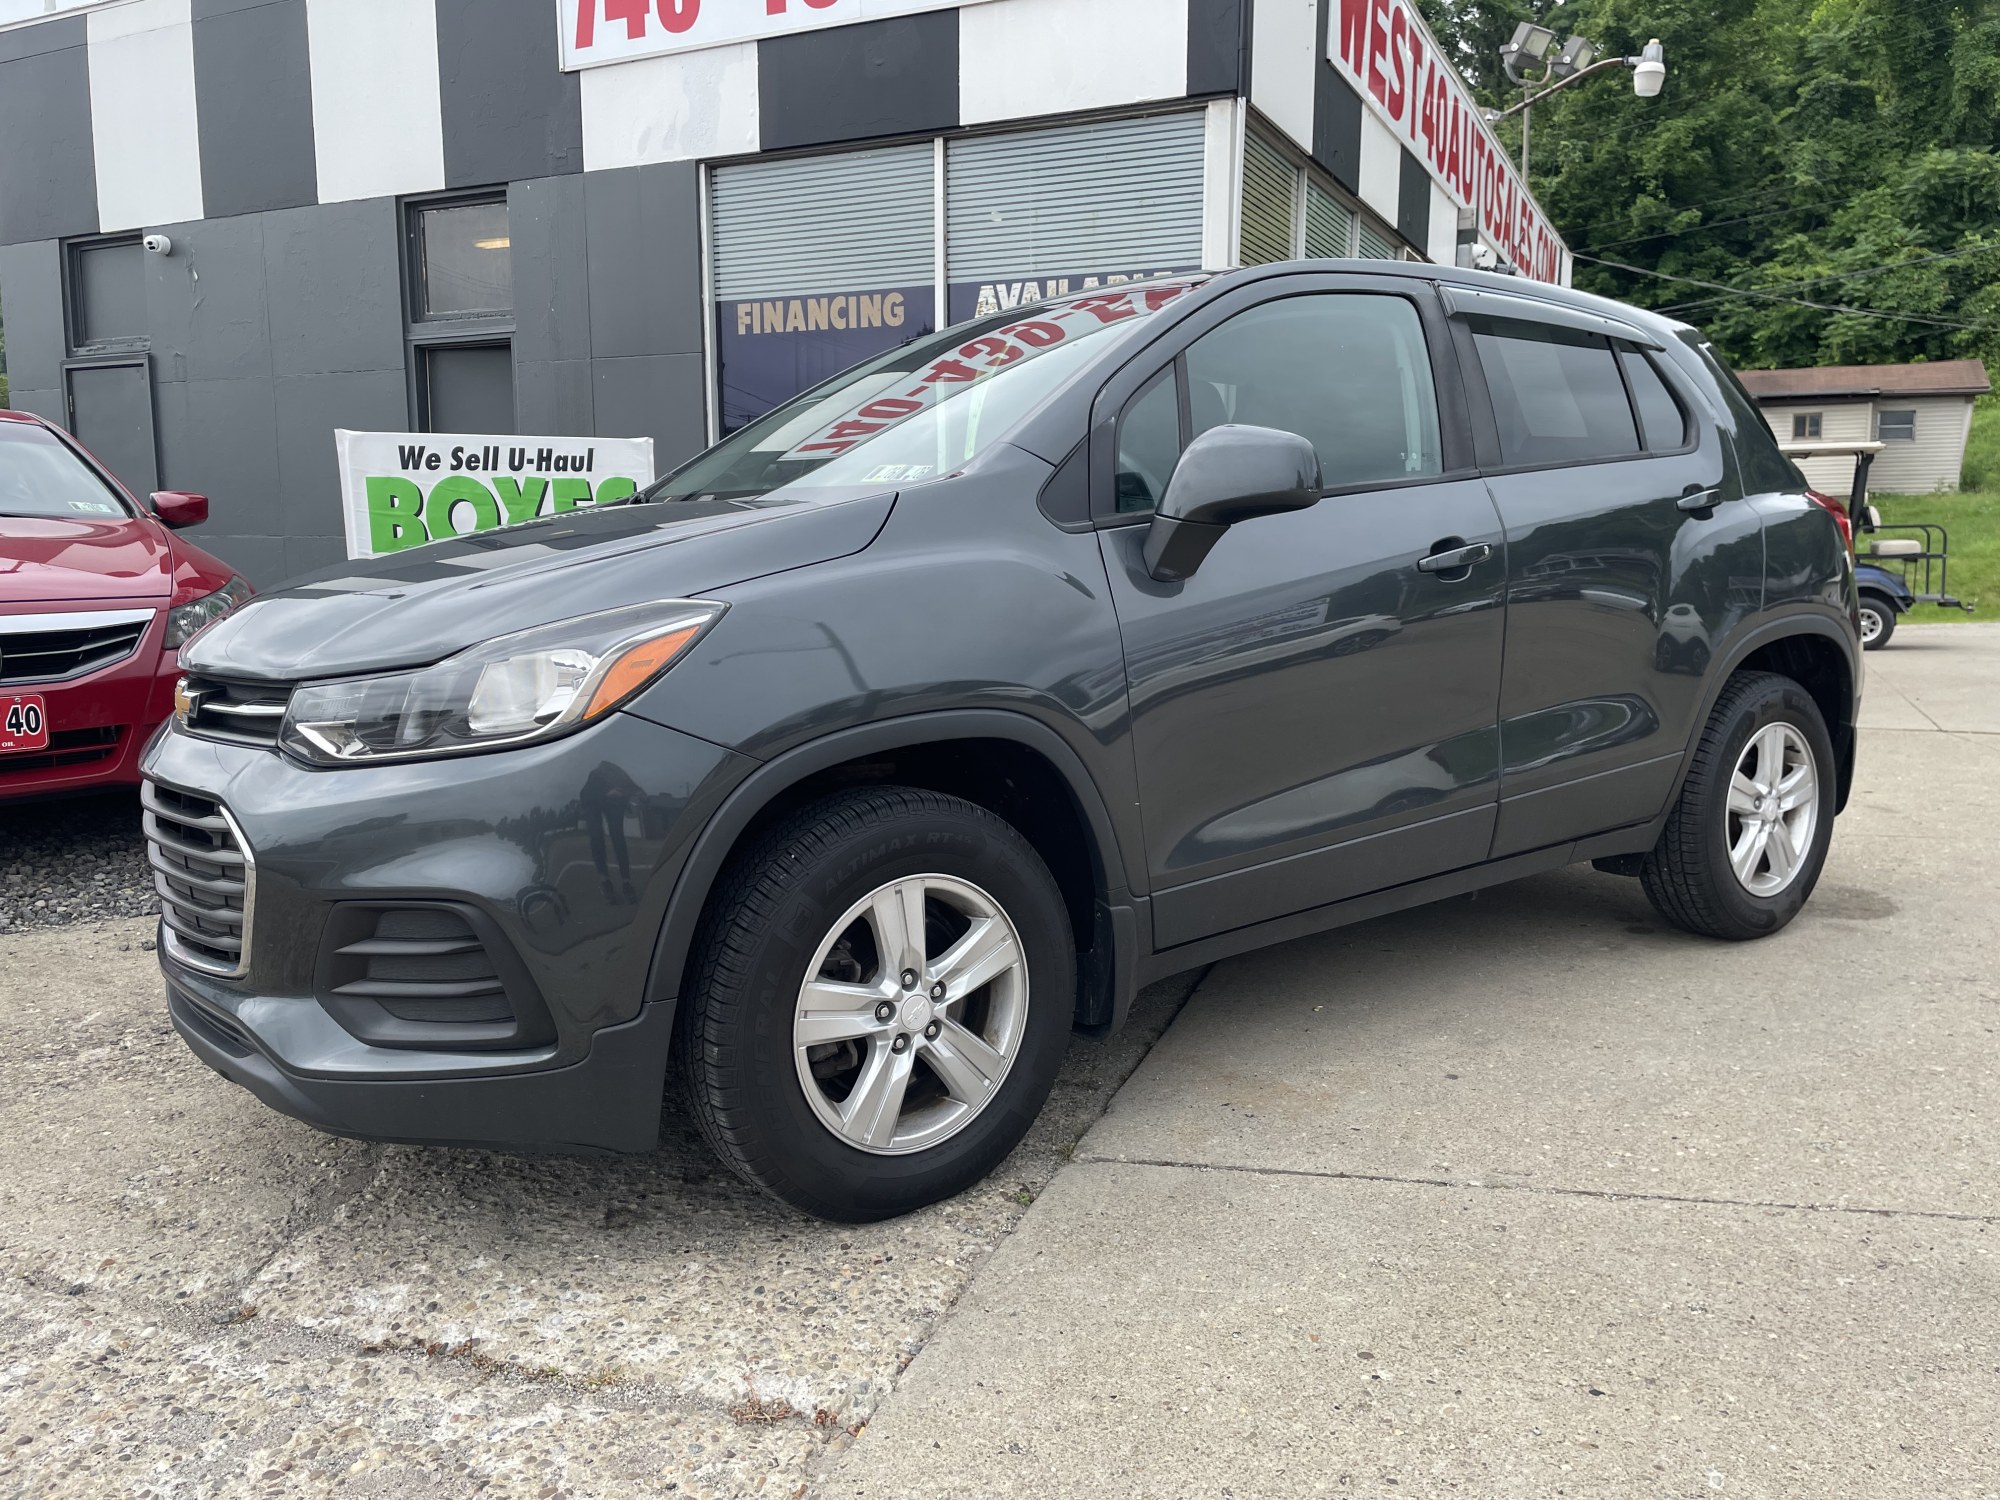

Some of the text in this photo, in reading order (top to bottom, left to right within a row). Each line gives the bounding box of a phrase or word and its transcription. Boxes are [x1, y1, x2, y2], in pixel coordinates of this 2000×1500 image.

[737, 291, 905, 336] FINANCING
[398, 445, 596, 473] We Sell U-Haul
[6, 704, 42, 736] 40
